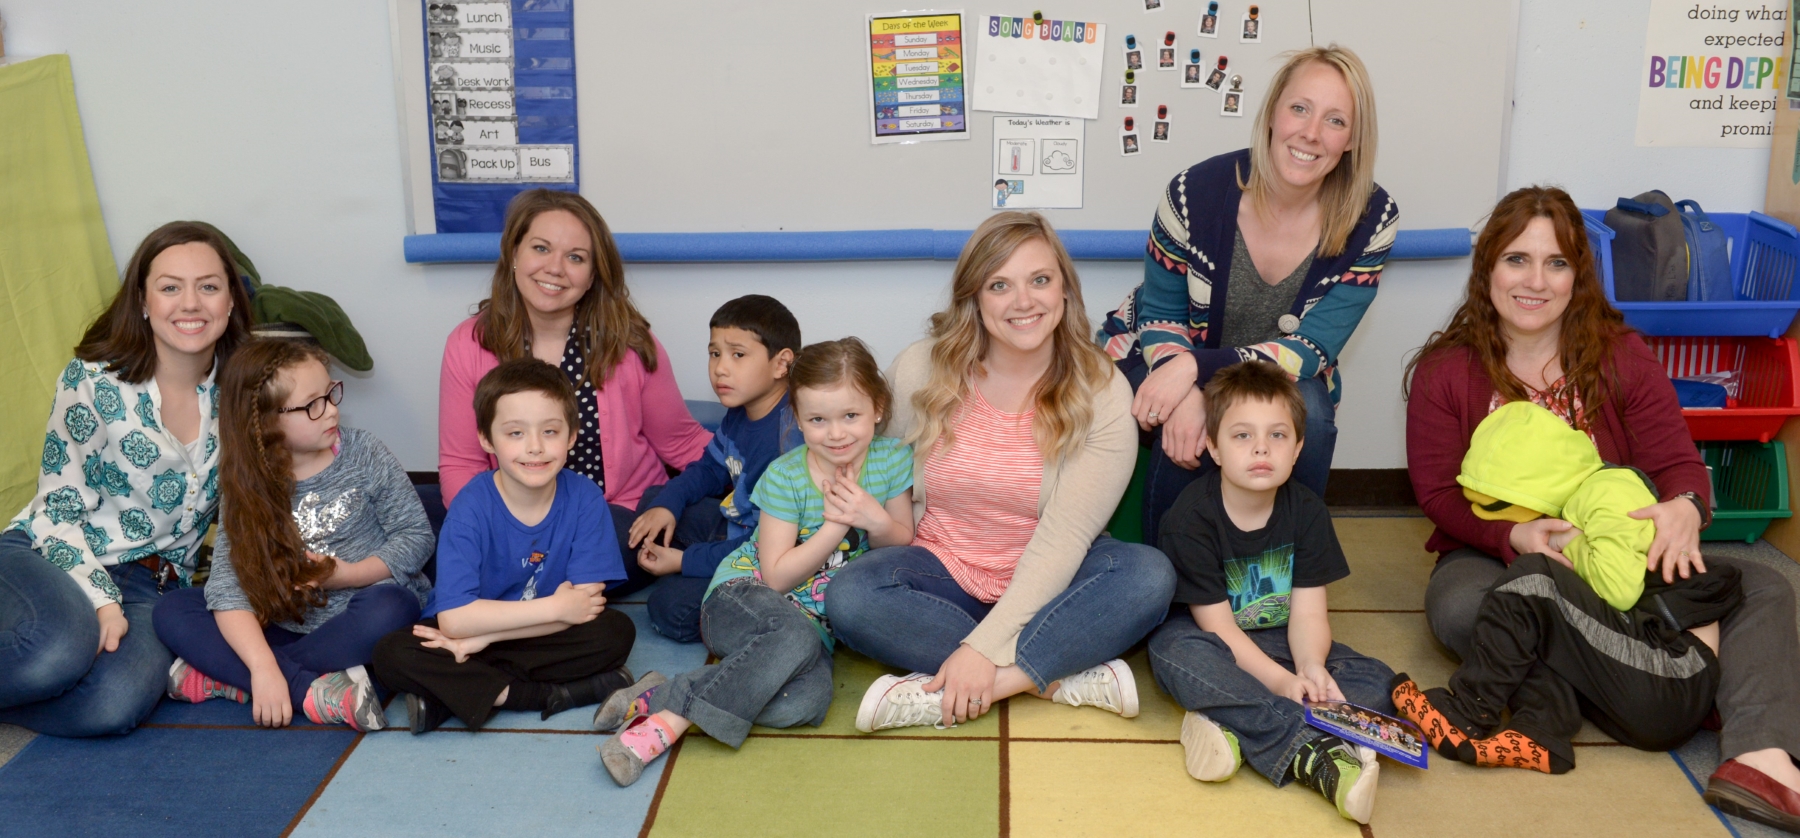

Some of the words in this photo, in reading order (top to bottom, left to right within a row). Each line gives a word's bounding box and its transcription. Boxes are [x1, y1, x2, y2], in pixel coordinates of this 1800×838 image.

[466, 12, 503, 23] Lunch
[1687, 4, 1740, 22] doing
[882, 22, 901, 31] Days
[902, 21, 912, 29] of
[927, 20, 949, 28] Week
[990, 19, 1032, 36] SONG
[1042, 22, 1094, 40] BOARD
[904, 36, 928, 44] Sunday
[1704, 31, 1785, 48] expected
[469, 43, 501, 54] Music
[903, 50, 930, 58] Monday
[904, 64, 931, 72] Tuesday
[1648, 55, 1722, 89] BEING
[457, 77, 481, 87] Desk
[483, 77, 510, 86] Work
[898, 77, 938, 86] Wednesday
[905, 92, 933, 101] Thursday
[469, 99, 511, 110] Recess
[1689, 95, 1724, 110] and
[909, 107, 930, 115] Friday
[905, 120, 934, 129] Saturday
[1007, 119, 1033, 129] Today's
[1064, 118, 1071, 126] is
[1720, 121, 1774, 137] promi
[479, 129, 500, 139] Art
[471, 158, 498, 169] Pack
[499, 158, 515, 171] Up
[529, 156, 552, 167] Bus
